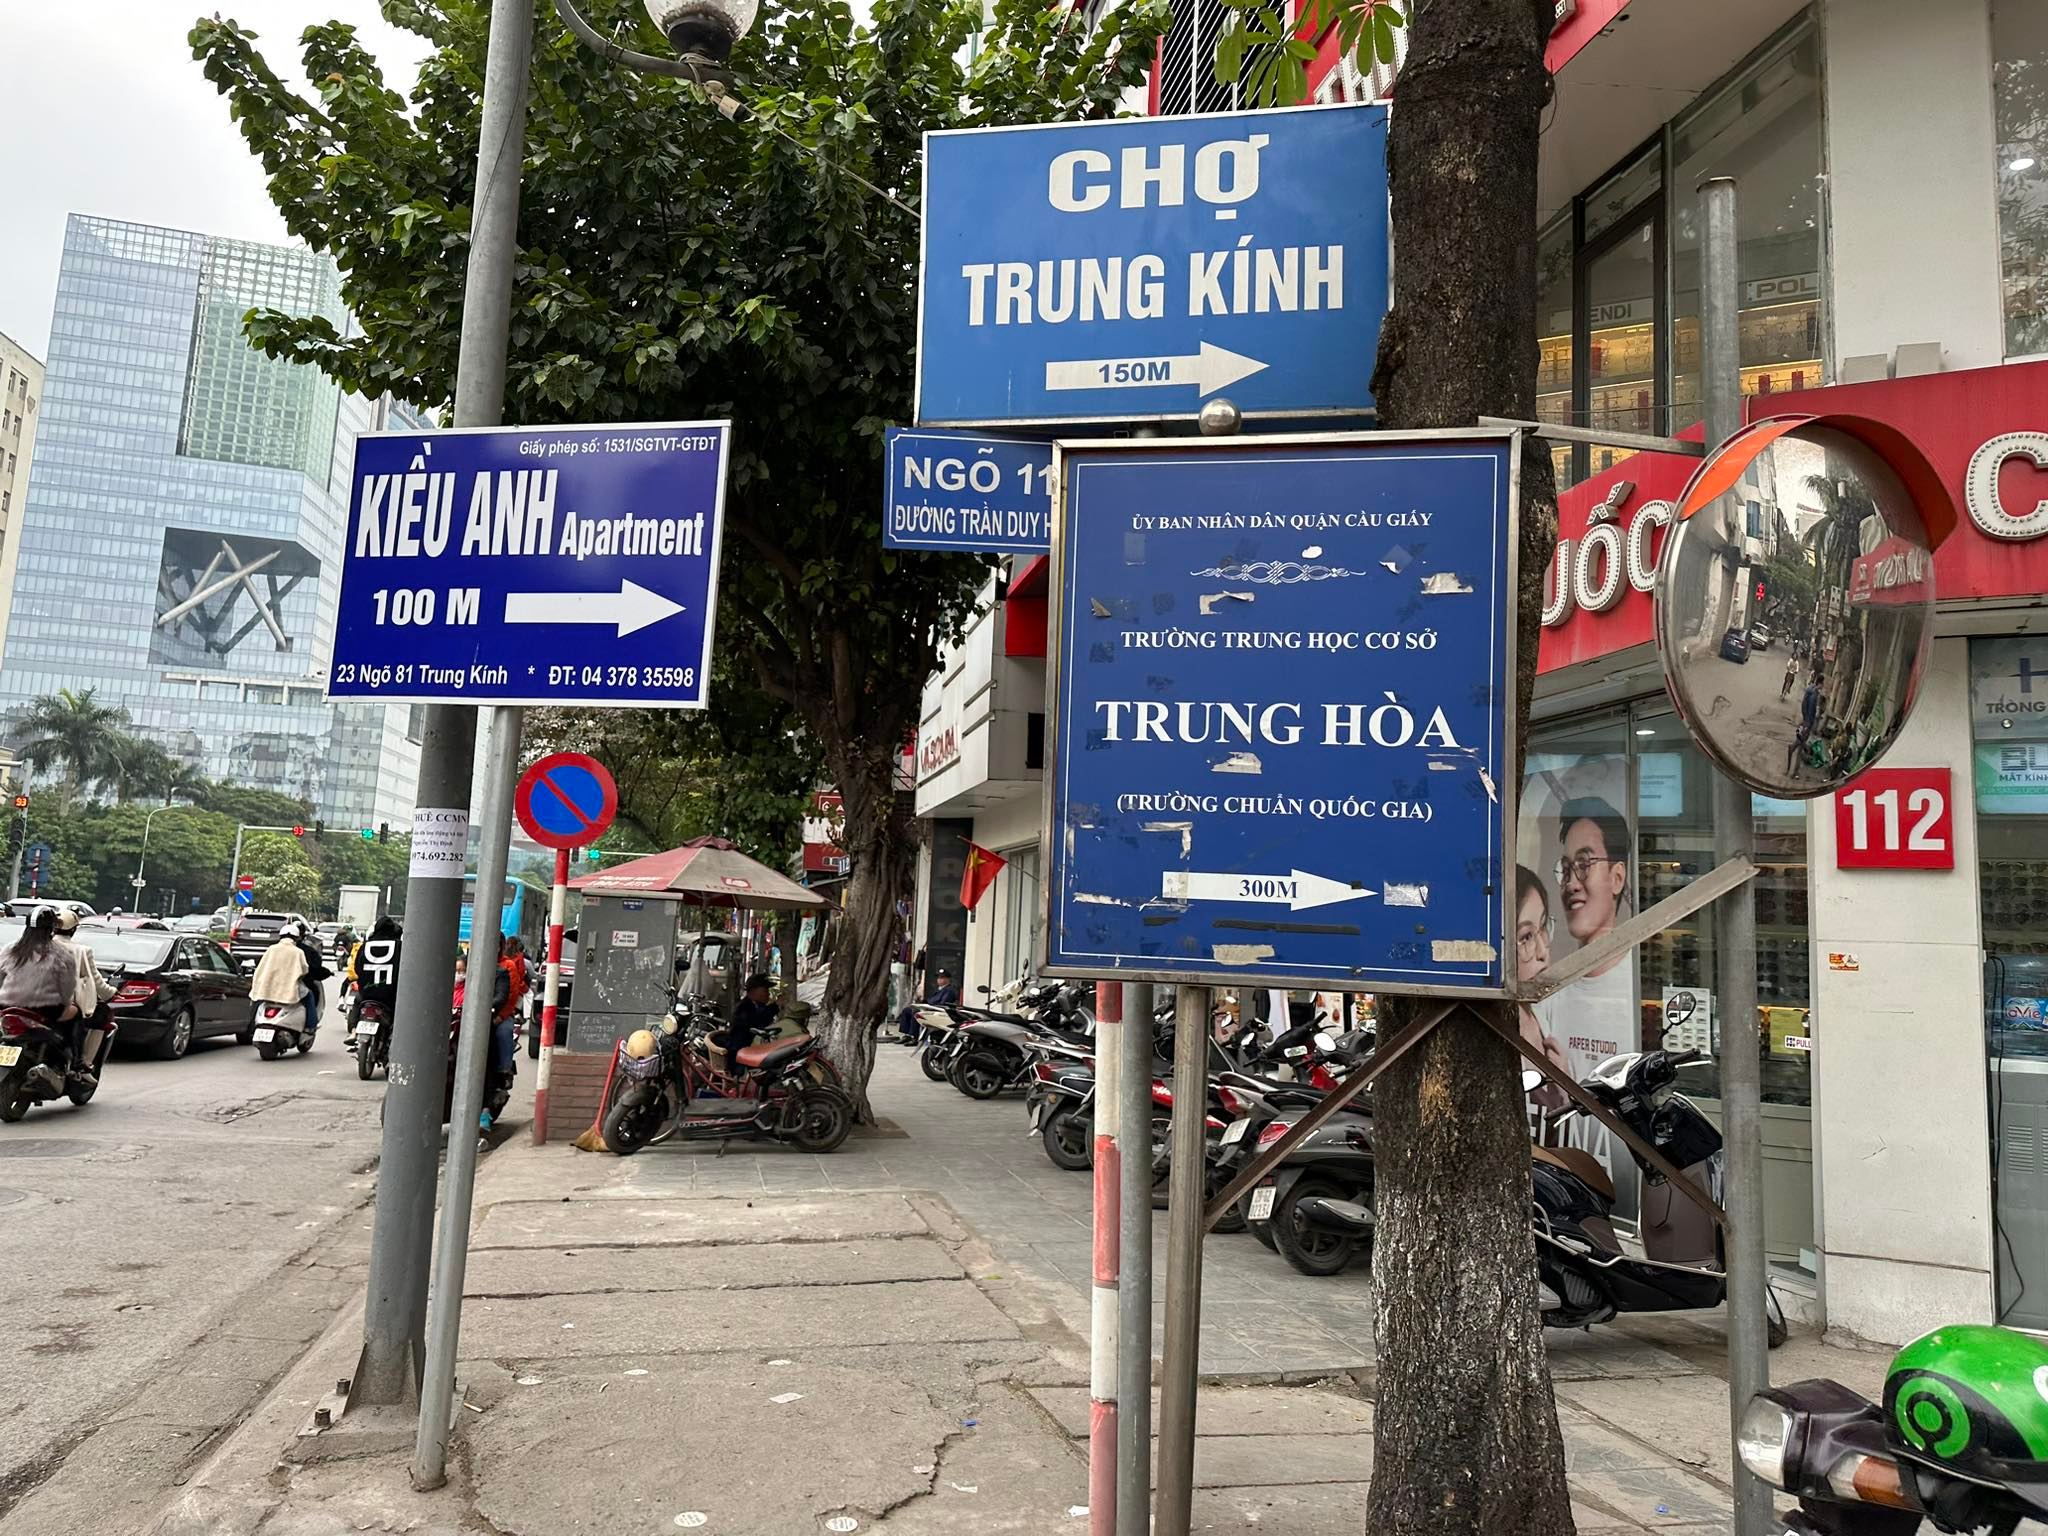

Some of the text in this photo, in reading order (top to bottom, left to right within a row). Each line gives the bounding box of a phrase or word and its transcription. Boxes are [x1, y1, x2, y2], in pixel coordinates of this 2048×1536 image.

[1049, 134, 1269, 220] CHỢ
[962, 234, 1344, 326] TRUNG KÍNH
[1099, 361, 1170, 384] 150M
[520, 440, 546, 457] Giấy
[549, 440, 578, 457] phép
[604, 436, 717, 453] 1531/SGTVT-GTĐT
[904, 447, 1000, 493] NGÕ
[355, 442, 704, 560] KIỀU ANH Apartment
[895, 499, 956, 534] ĐƯỜNG
[960, 501, 1003, 536] TRẦN
[1007, 511, 1040, 538] DUY
[1132, 509, 1433, 531] ỦY BAN NHÂN DÂN QUẬN CẦU GIẤY
[372, 588, 481, 625] 100 M
[1121, 626, 1438, 653] TRƯỜNG TRUNG HỌC CƠ SỞ
[336, 664, 694, 689] 23 Ngõ 81 Trung Kính ĐT: 04 378 35598
[1095, 691, 1461, 748] TRUNG HÒA
[1116, 790, 1433, 823] (TRƯỜNG CHUẨN QUỐC GIA)
[1843, 788, 1945, 851] 112
[1239, 879, 1298, 898] 300M
[1569, 1037, 1617, 1056] PAPER STUDIO
